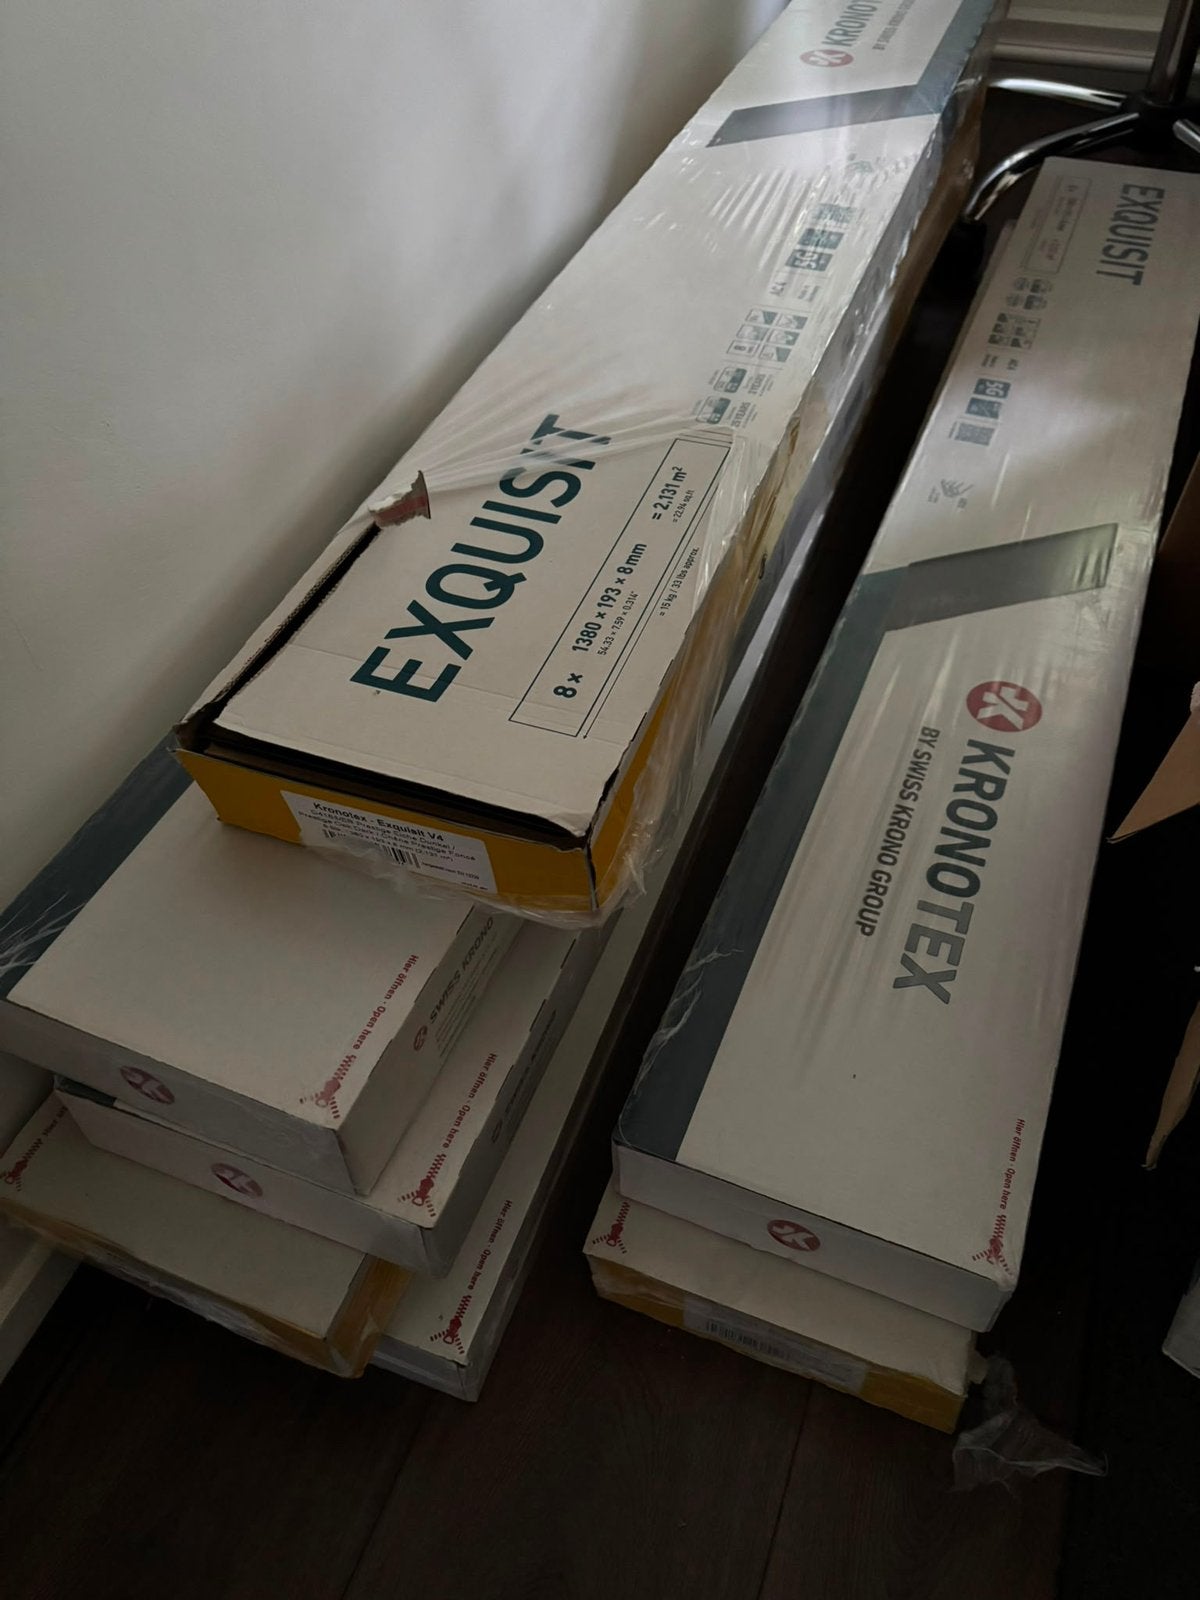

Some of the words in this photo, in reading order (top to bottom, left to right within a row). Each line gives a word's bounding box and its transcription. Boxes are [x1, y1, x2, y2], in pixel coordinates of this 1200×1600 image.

[821, 0, 884, 47] KRONO
[1096, 183, 1166, 286] EXQUISIT
[652, 482, 681, 512] 2,131
[350, 413, 612, 703] EXQUISIT
[666, 590, 678, 603] kg
[552, 685, 578, 699] 8
[571, 621, 603, 653] 1380
[596, 586, 622, 609] 193
[919, 725, 941, 749] BY
[899, 750, 933, 802] SWISS
[313, 802, 368, 822] Kronotex
[376, 819, 425, 837] Exquisit
[427, 831, 444, 842] V4
[876, 805, 914, 867] KRONO
[893, 738, 1016, 1005] KRONOTEX
[854, 869, 893, 938] GROUP
[462, 916, 494, 971] KRONO
[402, 954, 419, 973] Hier
[384, 973, 407, 1000] öffnen
[366, 1005, 386, 1028] Open
[352, 1029, 372, 1050] here
[483, 1053, 498, 1071] Hier
[468, 1071, 488, 1099] öffnen
[454, 1104, 471, 1127] Open
[1015, 1118, 1026, 1136] Hier
[442, 1128, 459, 1149] here
[1009, 1136, 1025, 1162] öffnen
[1003, 1168, 1016, 1189] Open
[501, 1199, 513, 1217] Hier
[999, 1189, 1012, 1210] here
[476, 1249, 492, 1270] Open
[467, 1271, 482, 1290] here
